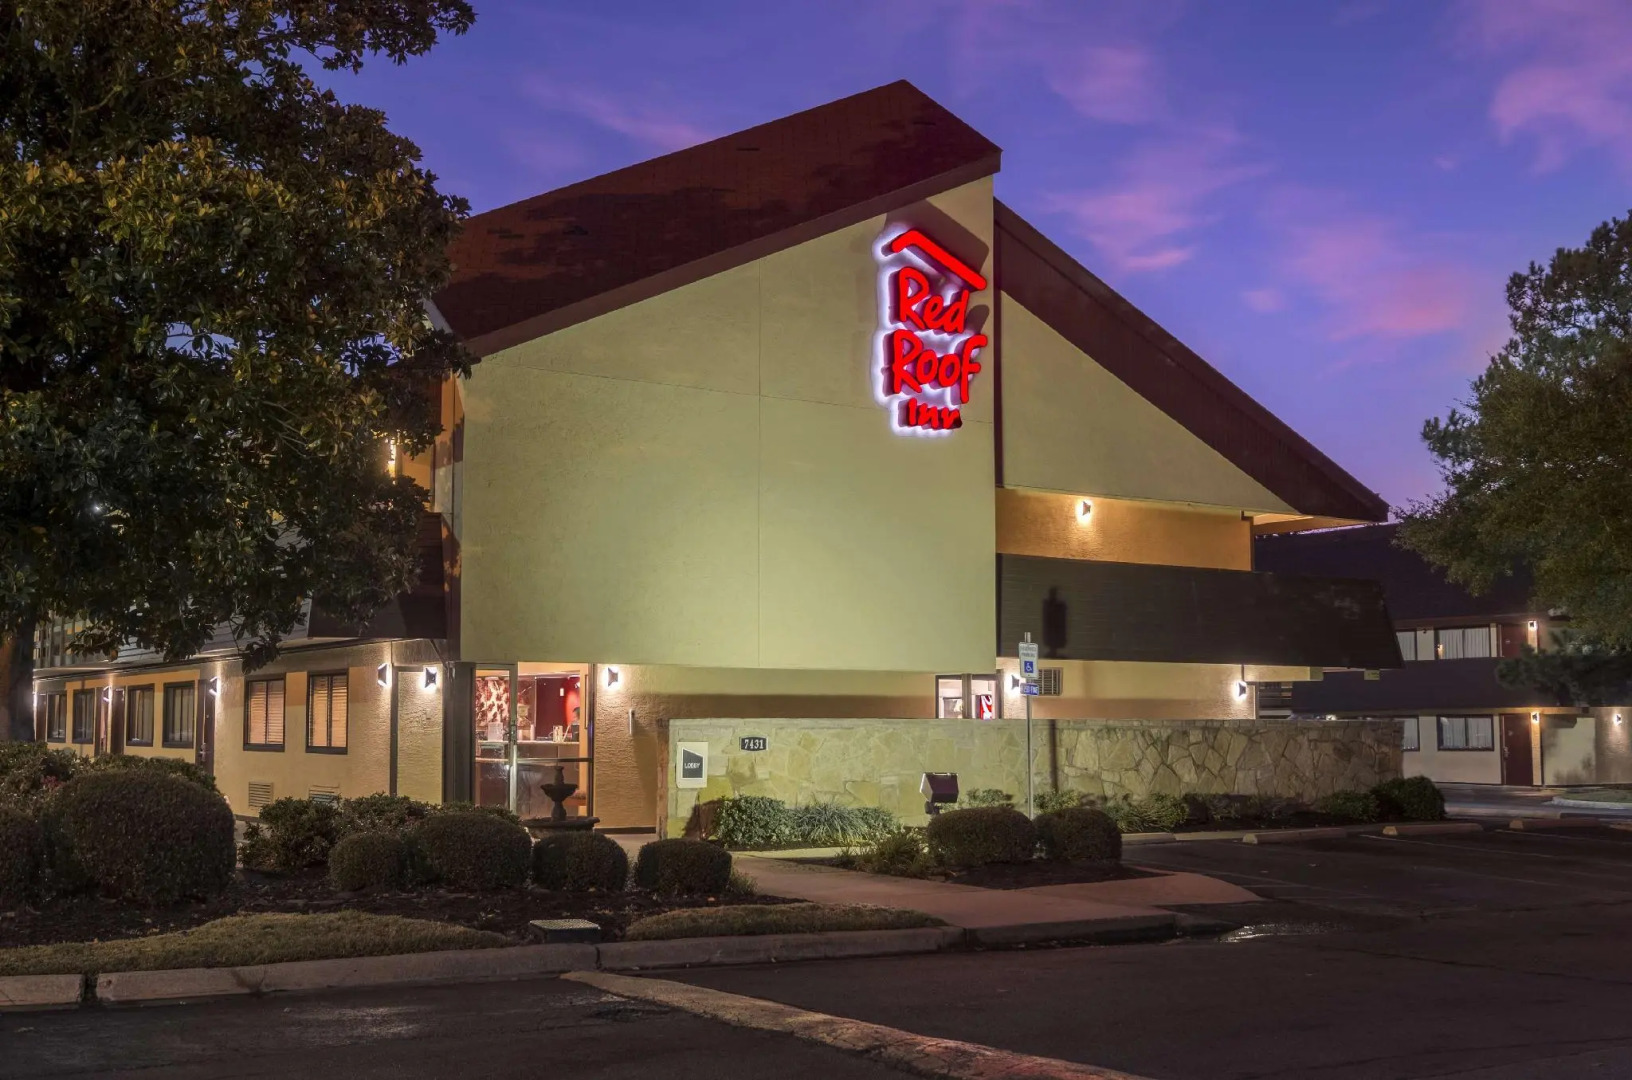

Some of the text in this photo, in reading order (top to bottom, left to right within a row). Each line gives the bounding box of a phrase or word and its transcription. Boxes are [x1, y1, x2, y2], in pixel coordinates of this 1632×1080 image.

[899, 266, 969, 333] Red
[892, 329, 988, 403] Roof
[908, 397, 962, 429] Inn
[744, 739, 764, 749] 7431
